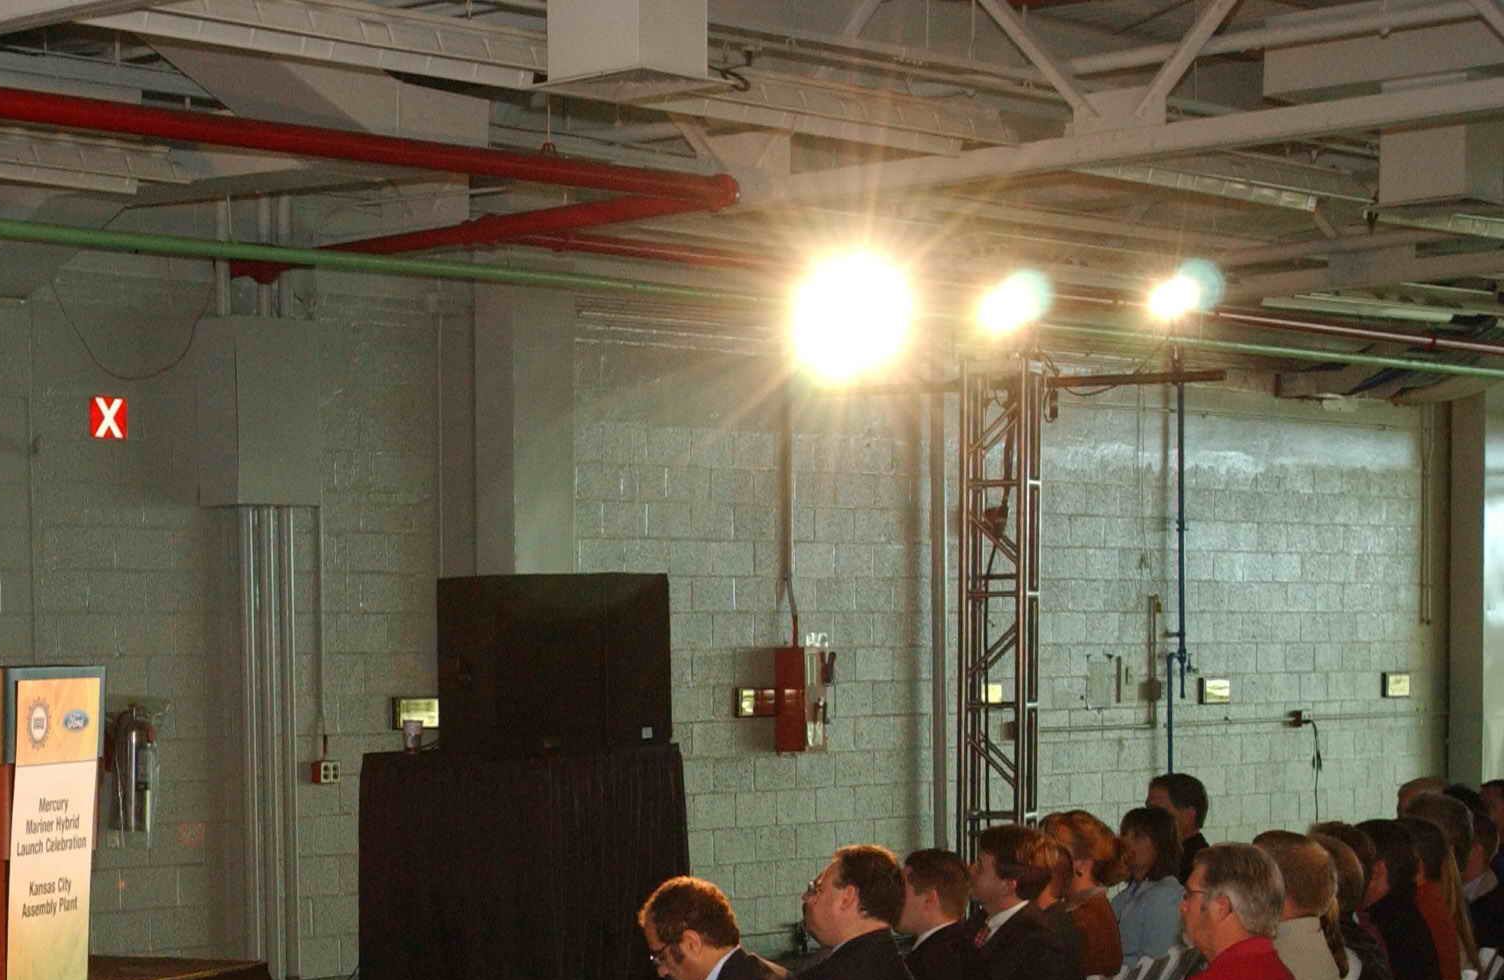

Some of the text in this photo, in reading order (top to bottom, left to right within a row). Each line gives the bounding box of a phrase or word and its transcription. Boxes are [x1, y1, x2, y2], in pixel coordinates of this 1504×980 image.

[95, 396, 124, 439] X
[38, 797, 70, 813] Mercury
[25, 814, 80, 834] Mariner Hybrid
[16, 835, 87, 857] Launch Celebration
[29, 876, 72, 897] Kansas City
[21, 896, 78, 920] Assembly Plant
